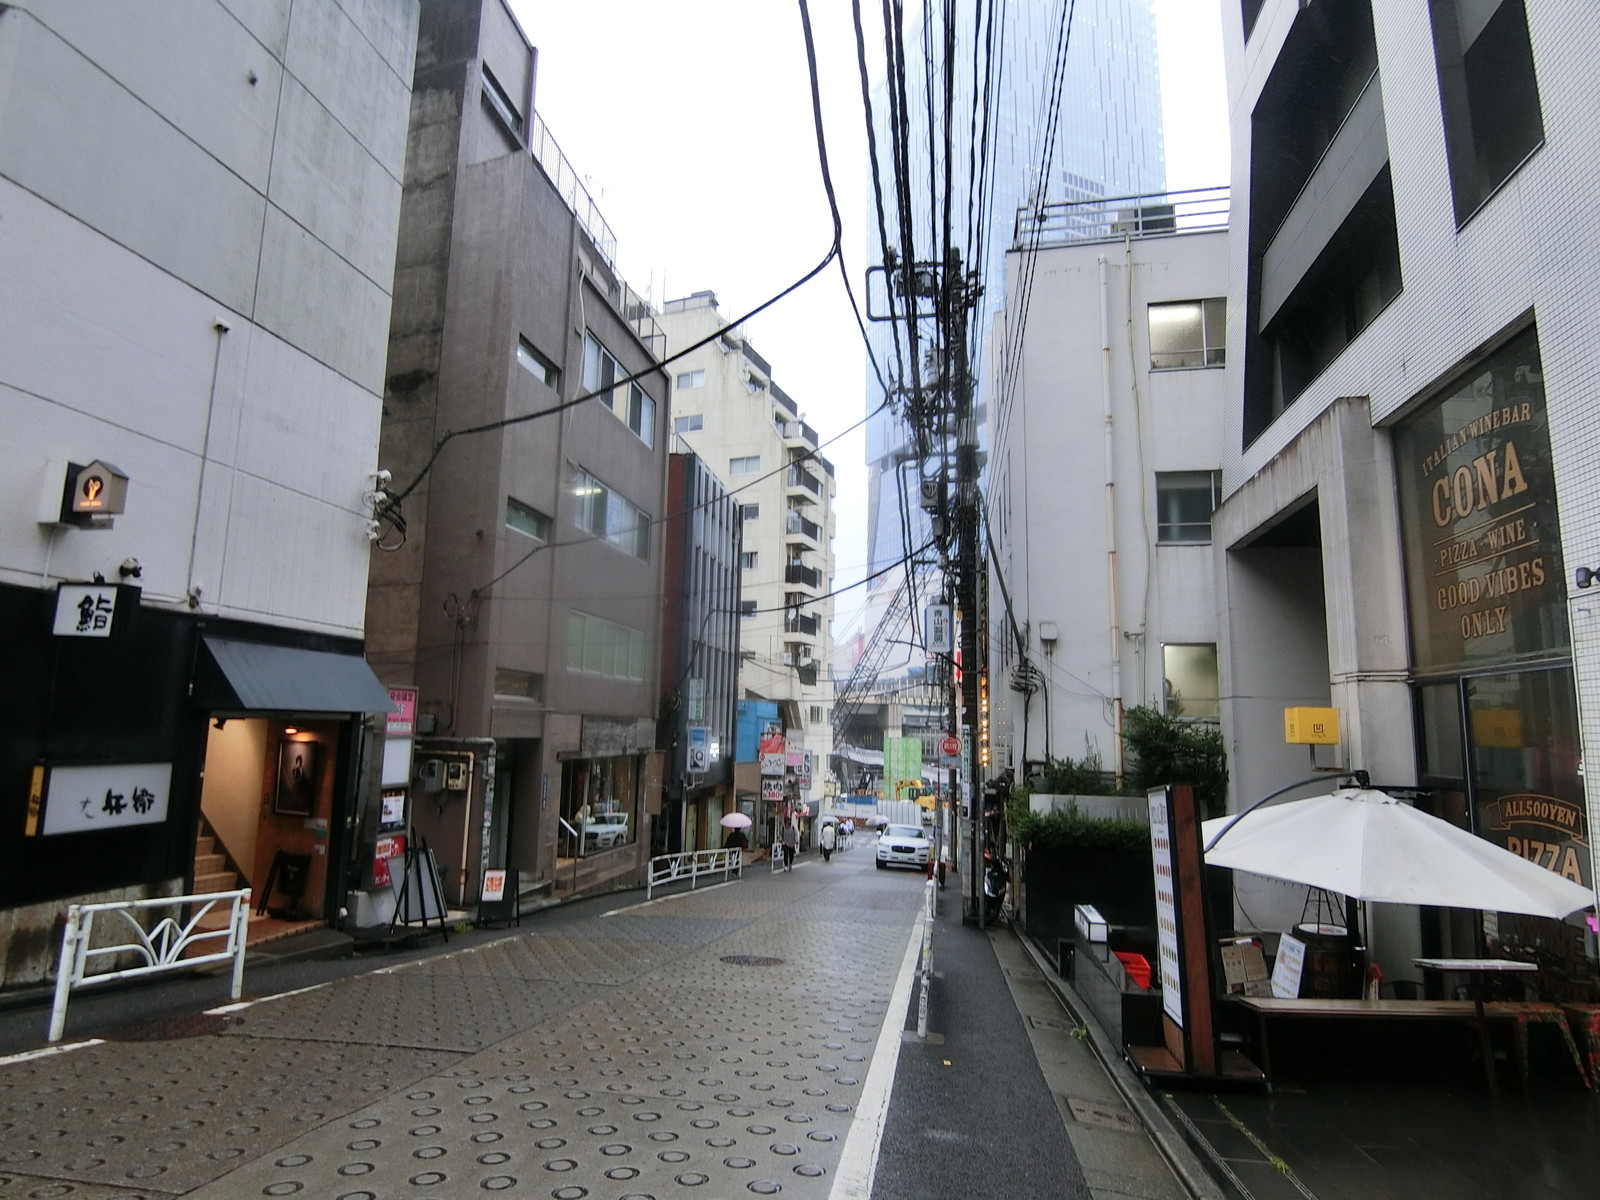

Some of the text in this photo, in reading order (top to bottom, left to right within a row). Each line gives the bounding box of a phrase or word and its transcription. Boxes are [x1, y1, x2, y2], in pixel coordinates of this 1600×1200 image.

[1422, 427, 1468, 477] ITALIAN
[1432, 440, 1529, 527] CONA
[1439, 518, 1526, 568] PIZZA WINE
[1437, 557, 1545, 611] GOOD VIBES
[76, 593, 113, 632] 鮨
[1461, 605, 1508, 639] ONLY
